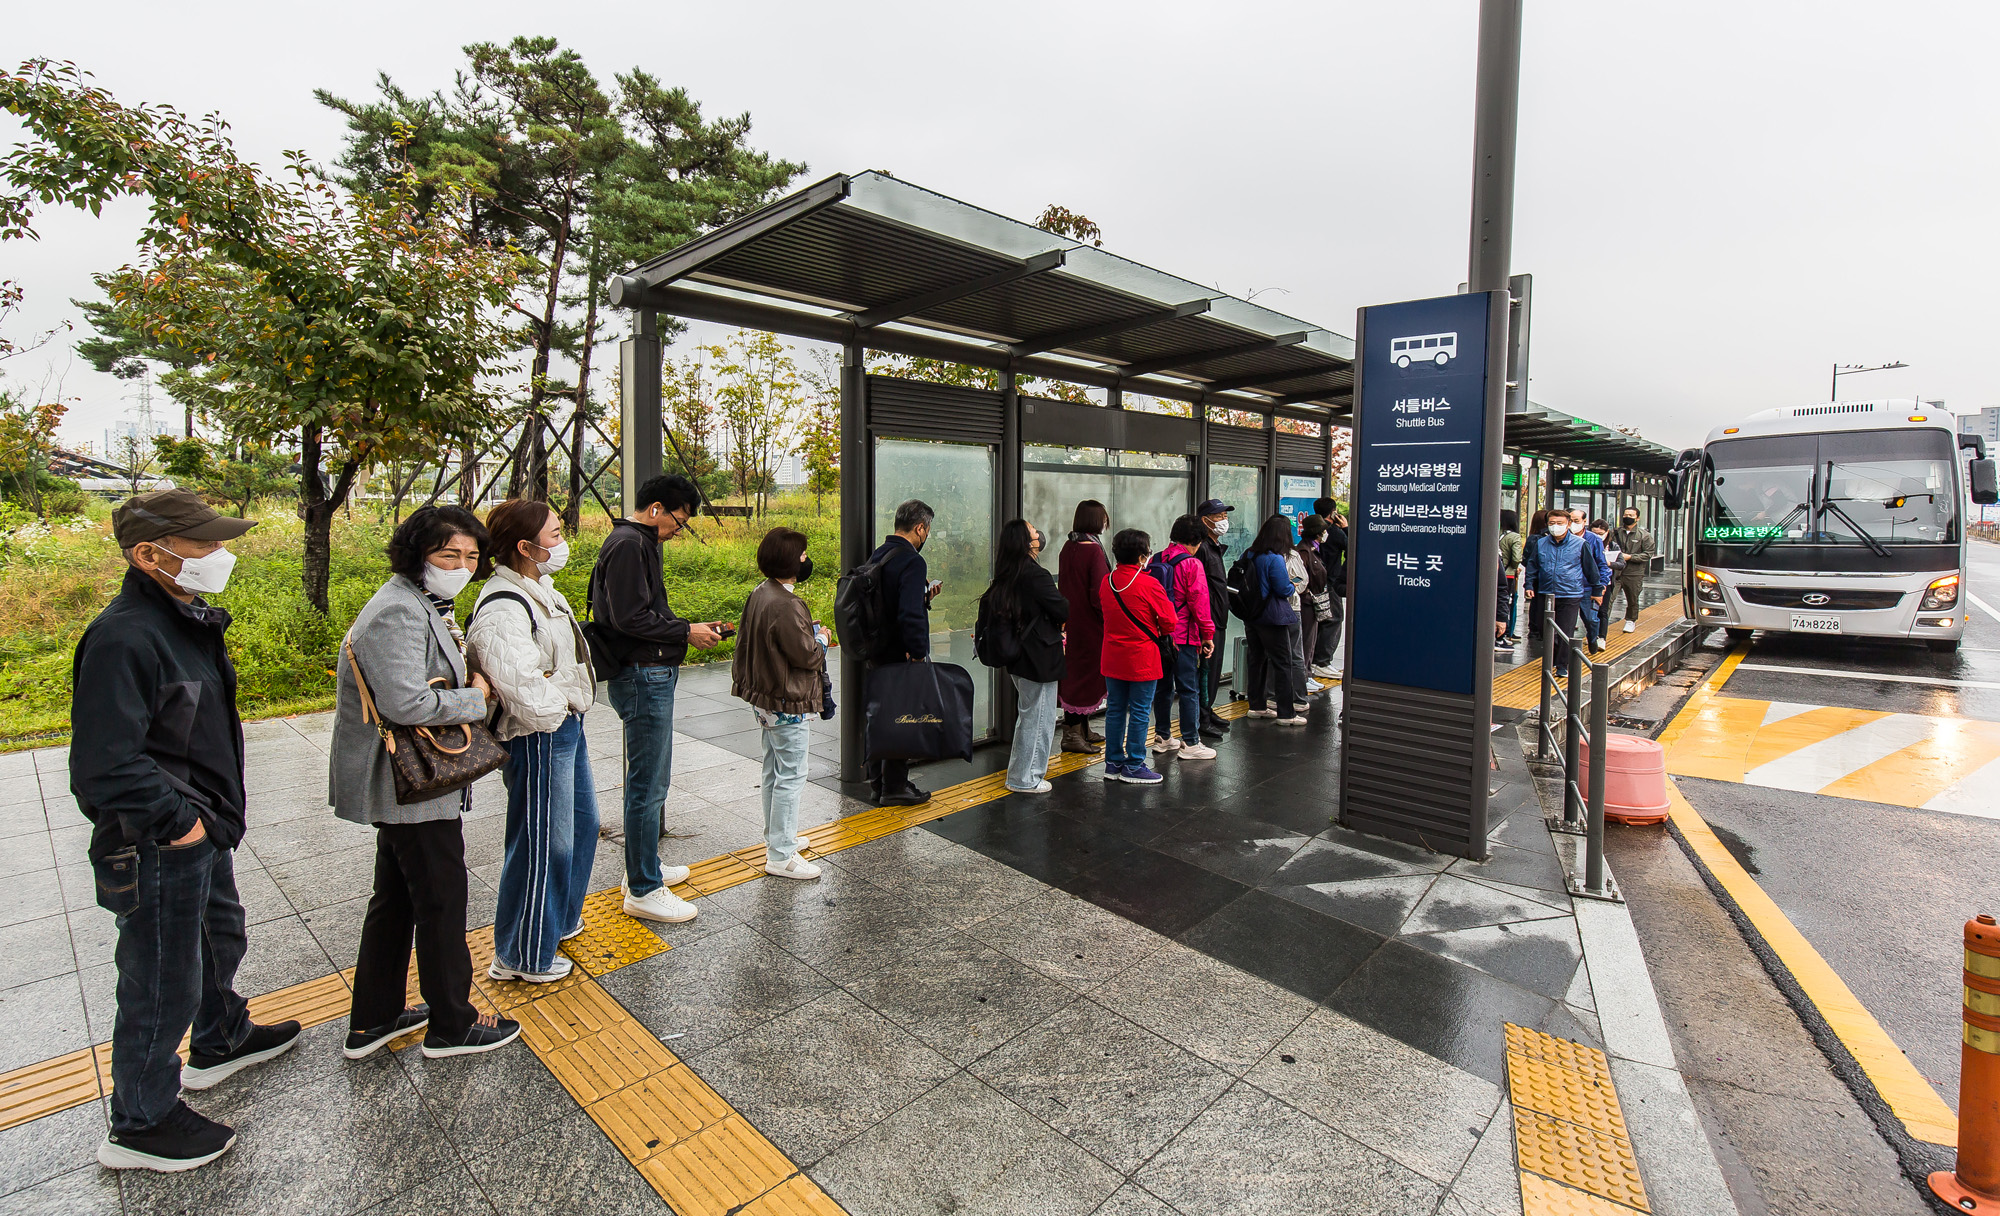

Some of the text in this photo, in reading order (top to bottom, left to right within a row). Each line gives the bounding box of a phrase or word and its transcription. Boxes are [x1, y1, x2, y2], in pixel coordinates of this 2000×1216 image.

[1391, 397, 1451, 413] 셔틀버스
[1395, 416, 1445, 428] Shuttle Bus
[1377, 462, 1462, 478] 삼성서울병원
[1376, 482, 1461, 494] Samsung Medical Center
[1368, 503, 1468, 519] 강남세브란스병원
[1368, 521, 1467, 536] Gangnam Severance Hospital
[1386, 552, 1444, 572] 타는 곳
[1397, 574, 1431, 588] Tracks
